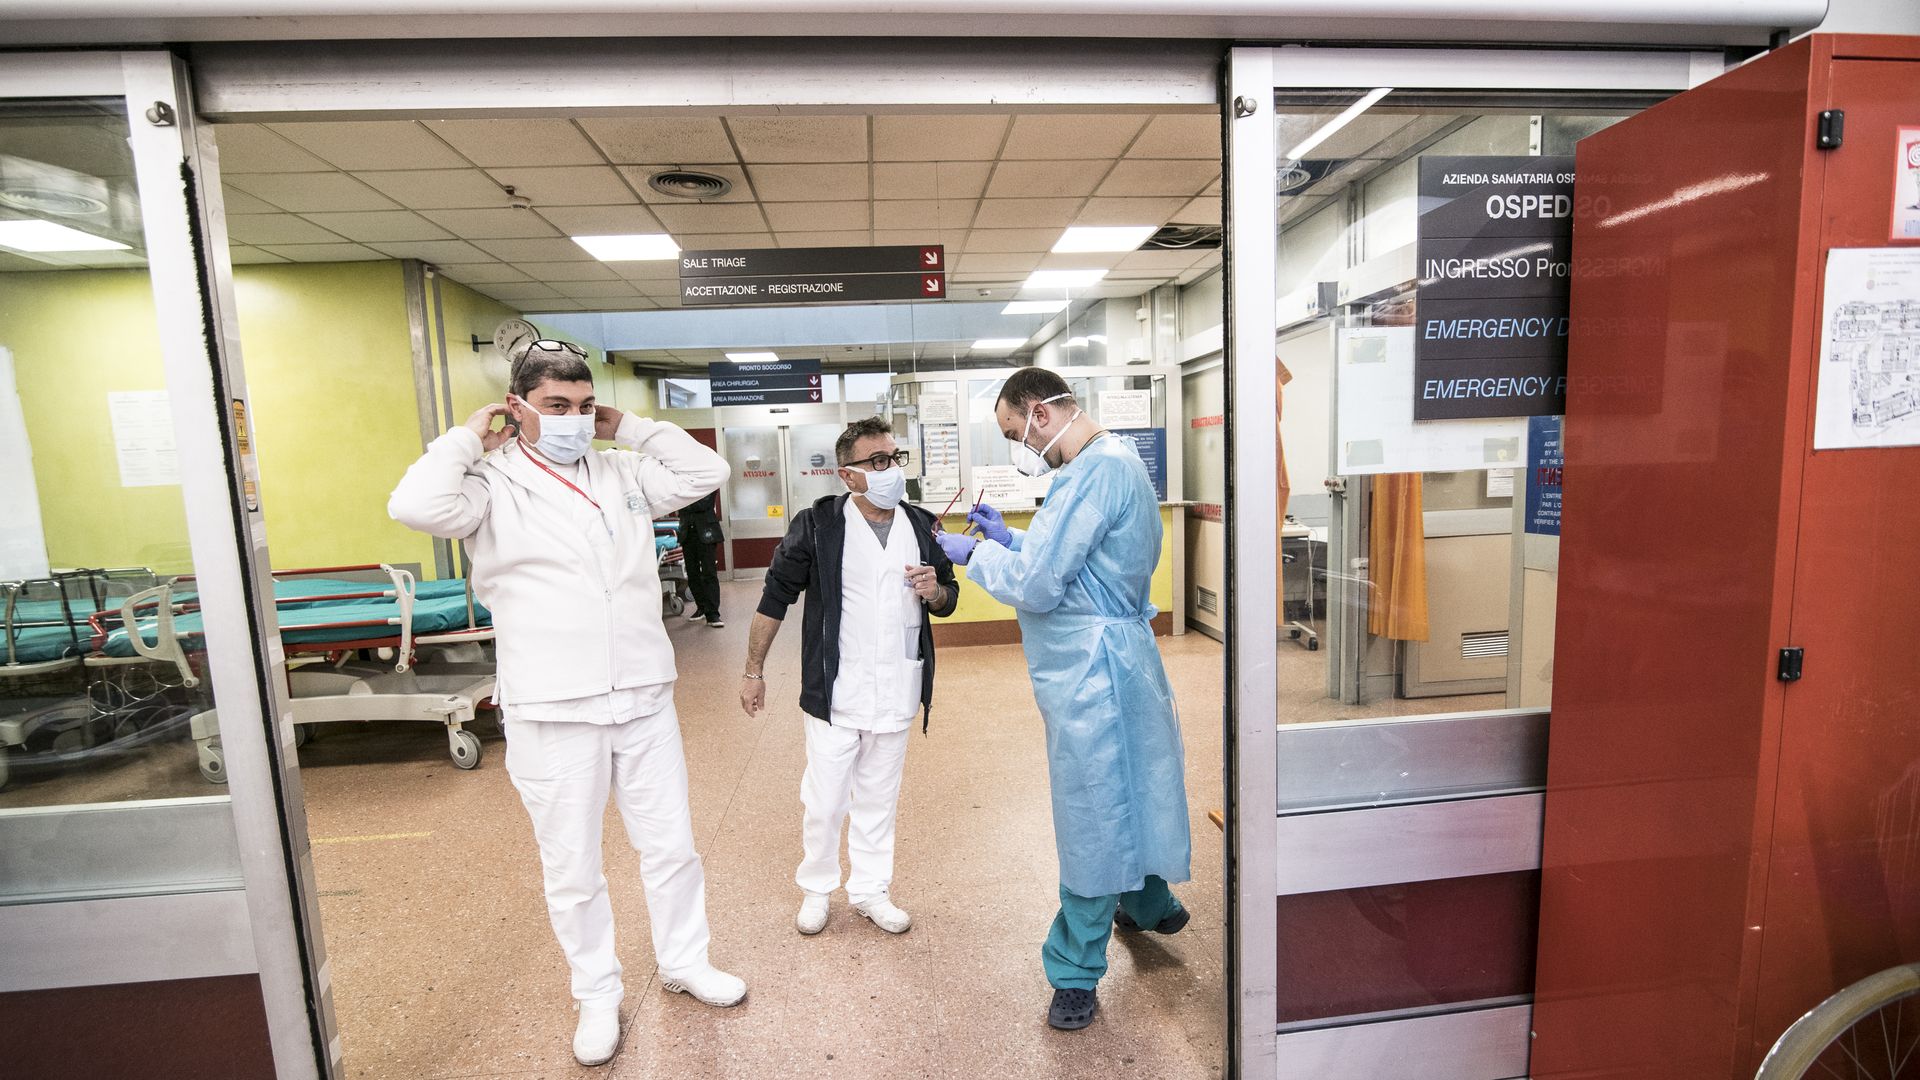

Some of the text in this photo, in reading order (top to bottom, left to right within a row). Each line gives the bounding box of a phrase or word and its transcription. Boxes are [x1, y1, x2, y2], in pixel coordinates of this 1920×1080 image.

[1442, 173, 1490, 185] AZIENDA
[1491, 173, 1554, 184] SANIATARIA
[1486, 194, 1574, 219] OSPED
[683, 257, 747, 269] SALE TRIAGE
[1425, 257, 1530, 279] INGRESSO
[685, 284, 757, 297] ACCETTAZIONE
[768, 282, 843, 295] REGISTRAZIONE
[1425, 317, 1553, 339] EMERGENCY
[1423, 375, 1552, 400] EMERGENCY
